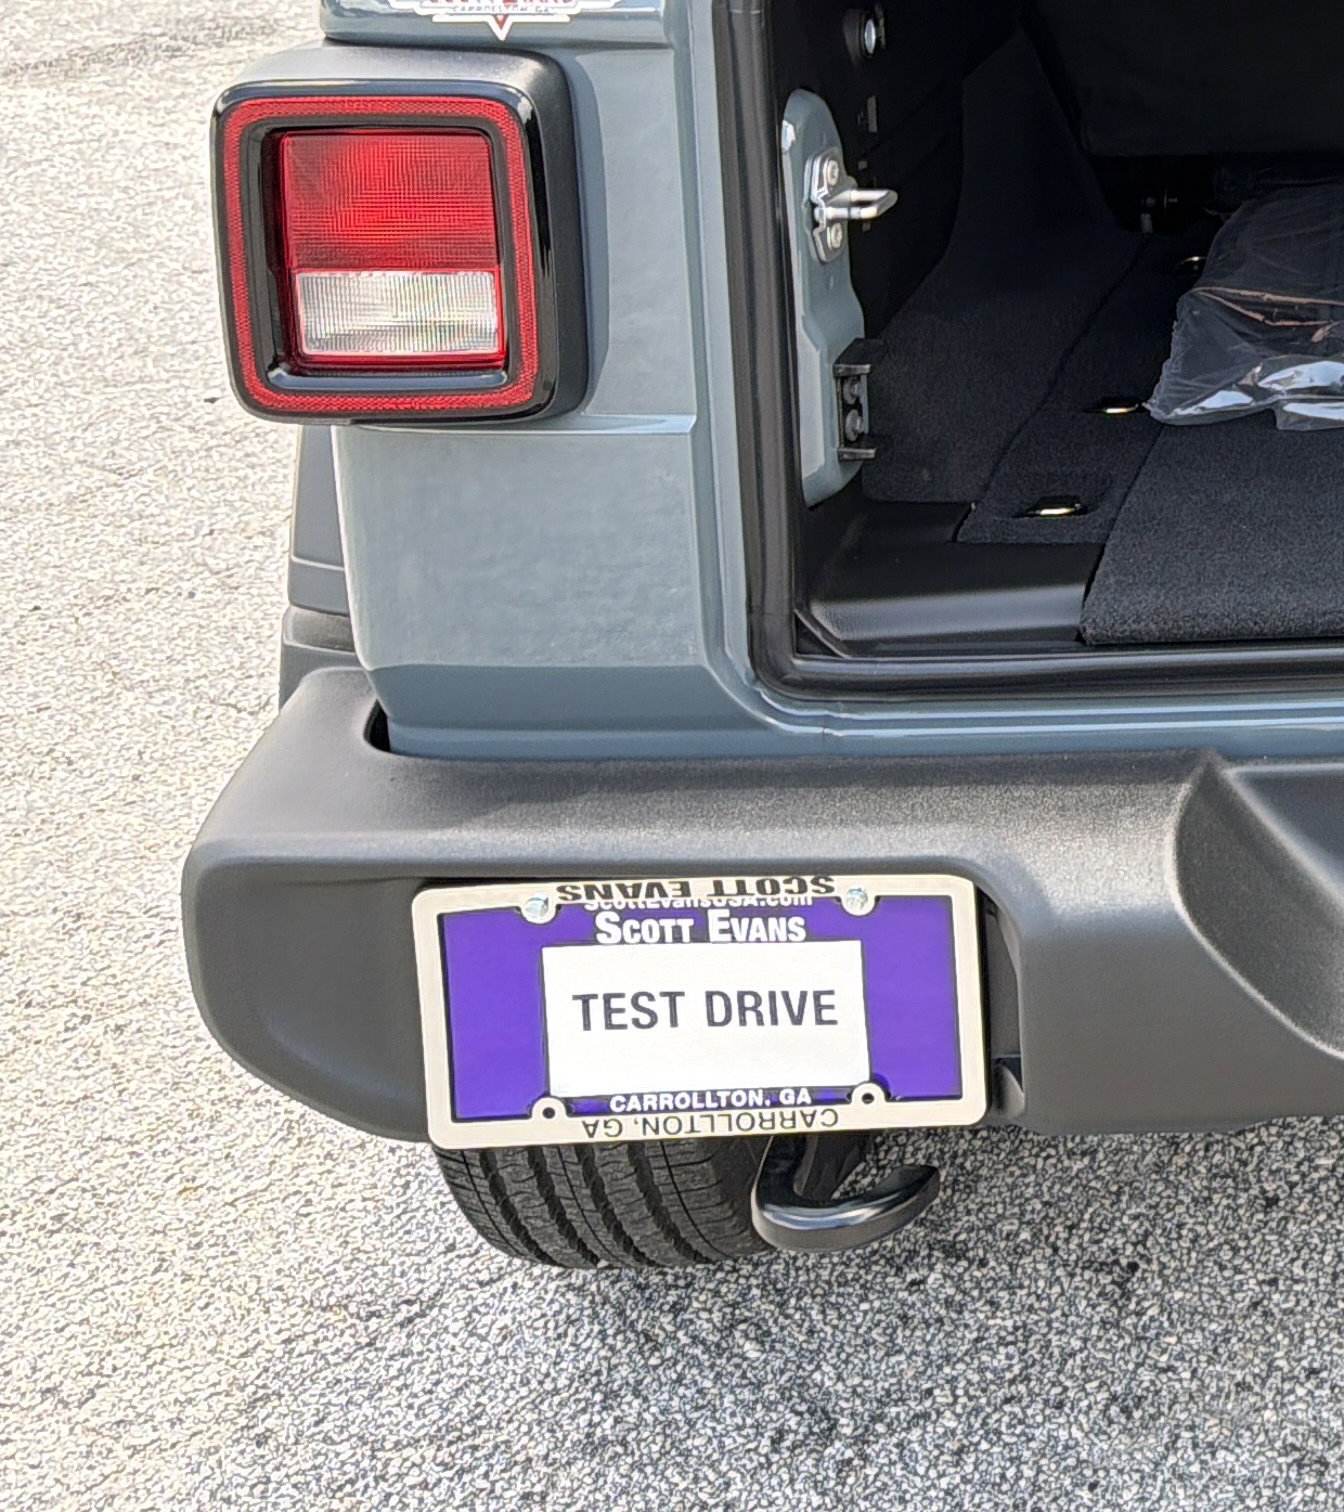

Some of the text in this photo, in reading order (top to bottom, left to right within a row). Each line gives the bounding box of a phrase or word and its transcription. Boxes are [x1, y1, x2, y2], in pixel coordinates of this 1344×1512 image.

[555, 875, 836, 902] SCOTT EVANS
[595, 908, 806, 945] SCOTT EVANS
[572, 990, 839, 1031] TEST DRIVE
[779, 1087, 812, 1105] GA
[581, 1108, 839, 1139] CARROLLTON, GA
